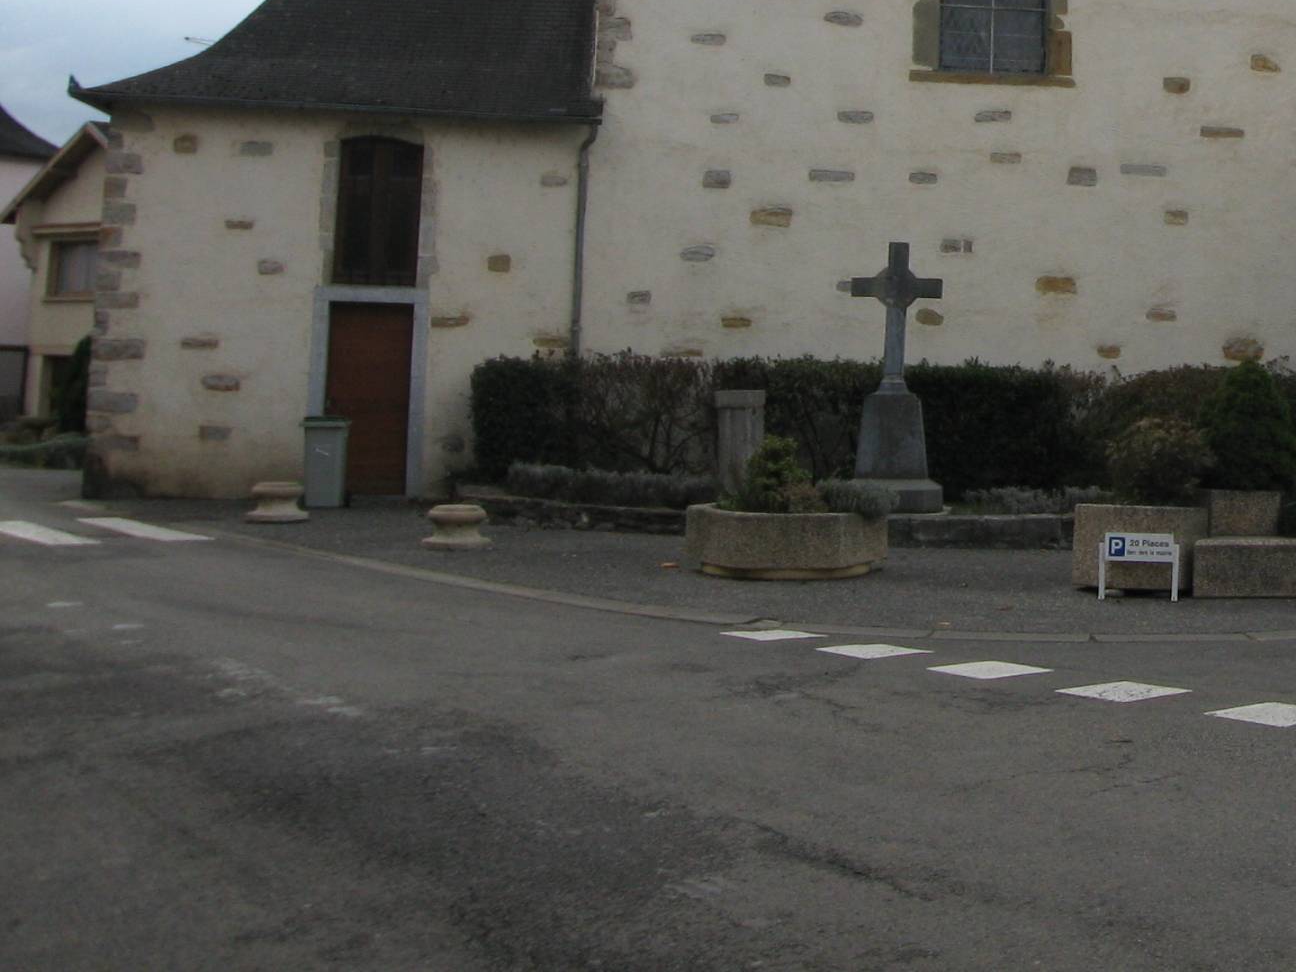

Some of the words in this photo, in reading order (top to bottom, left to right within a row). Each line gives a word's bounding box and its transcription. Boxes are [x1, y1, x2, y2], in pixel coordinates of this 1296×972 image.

[1111, 539, 1123, 554] P
[1129, 539, 1139, 547] 20
[1142, 539, 1169, 548] Places
